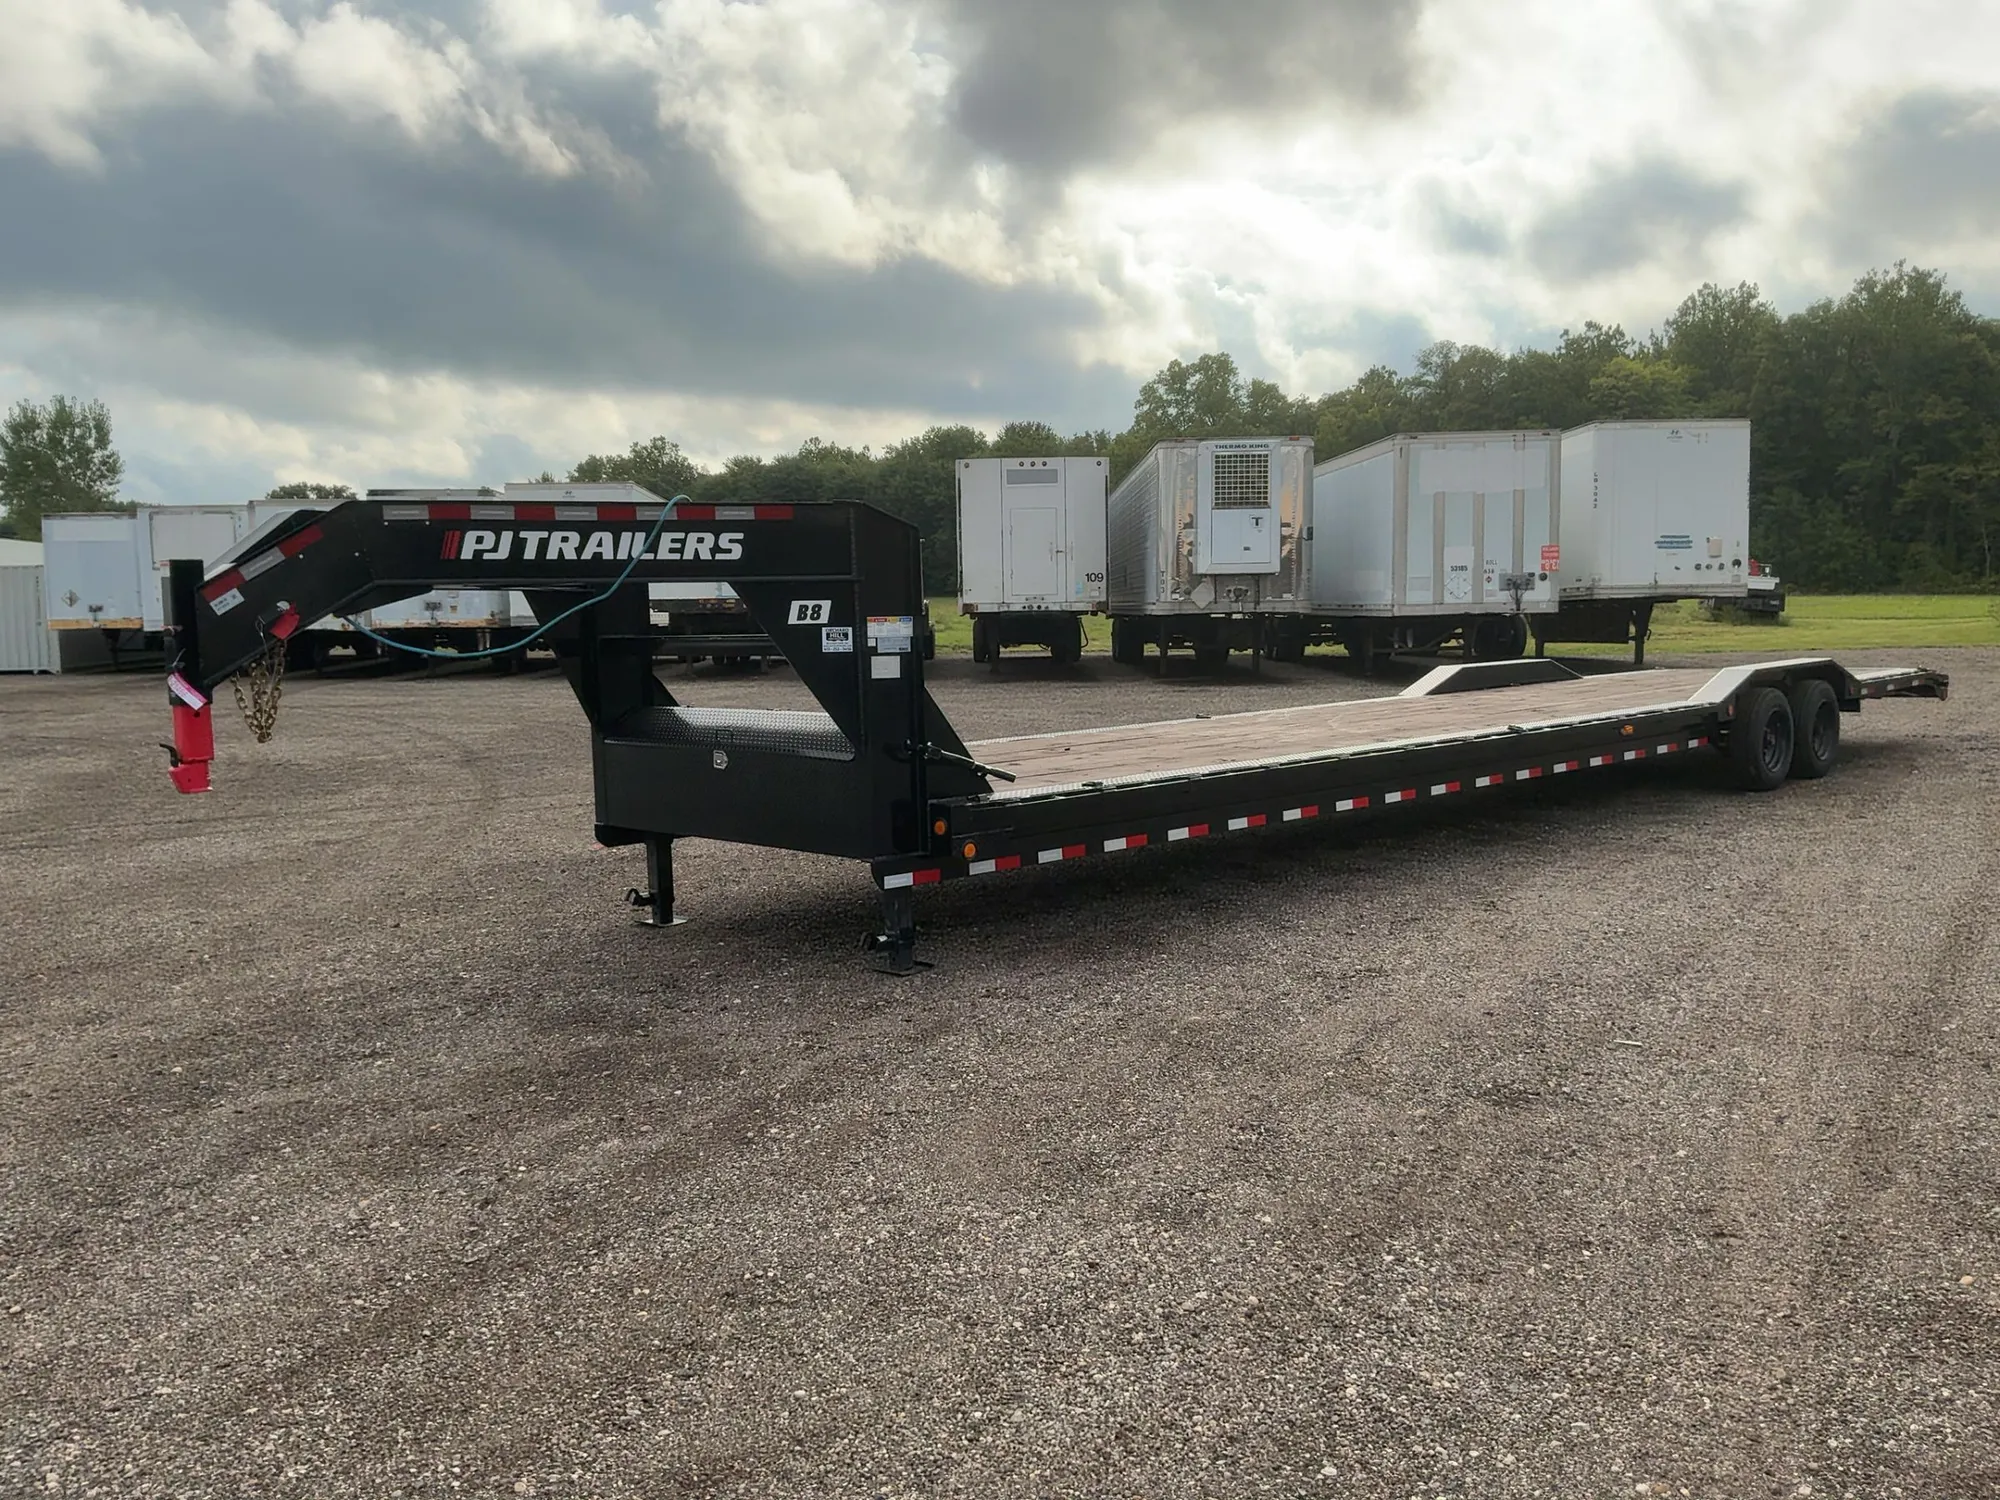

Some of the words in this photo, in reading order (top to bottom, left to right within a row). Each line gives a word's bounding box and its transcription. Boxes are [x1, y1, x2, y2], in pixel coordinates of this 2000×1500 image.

[460, 530, 514, 560] PJ
[518, 530, 744, 561] TRAILERS
[1084, 572, 1105, 583] 109
[796, 603, 823, 622] B8
